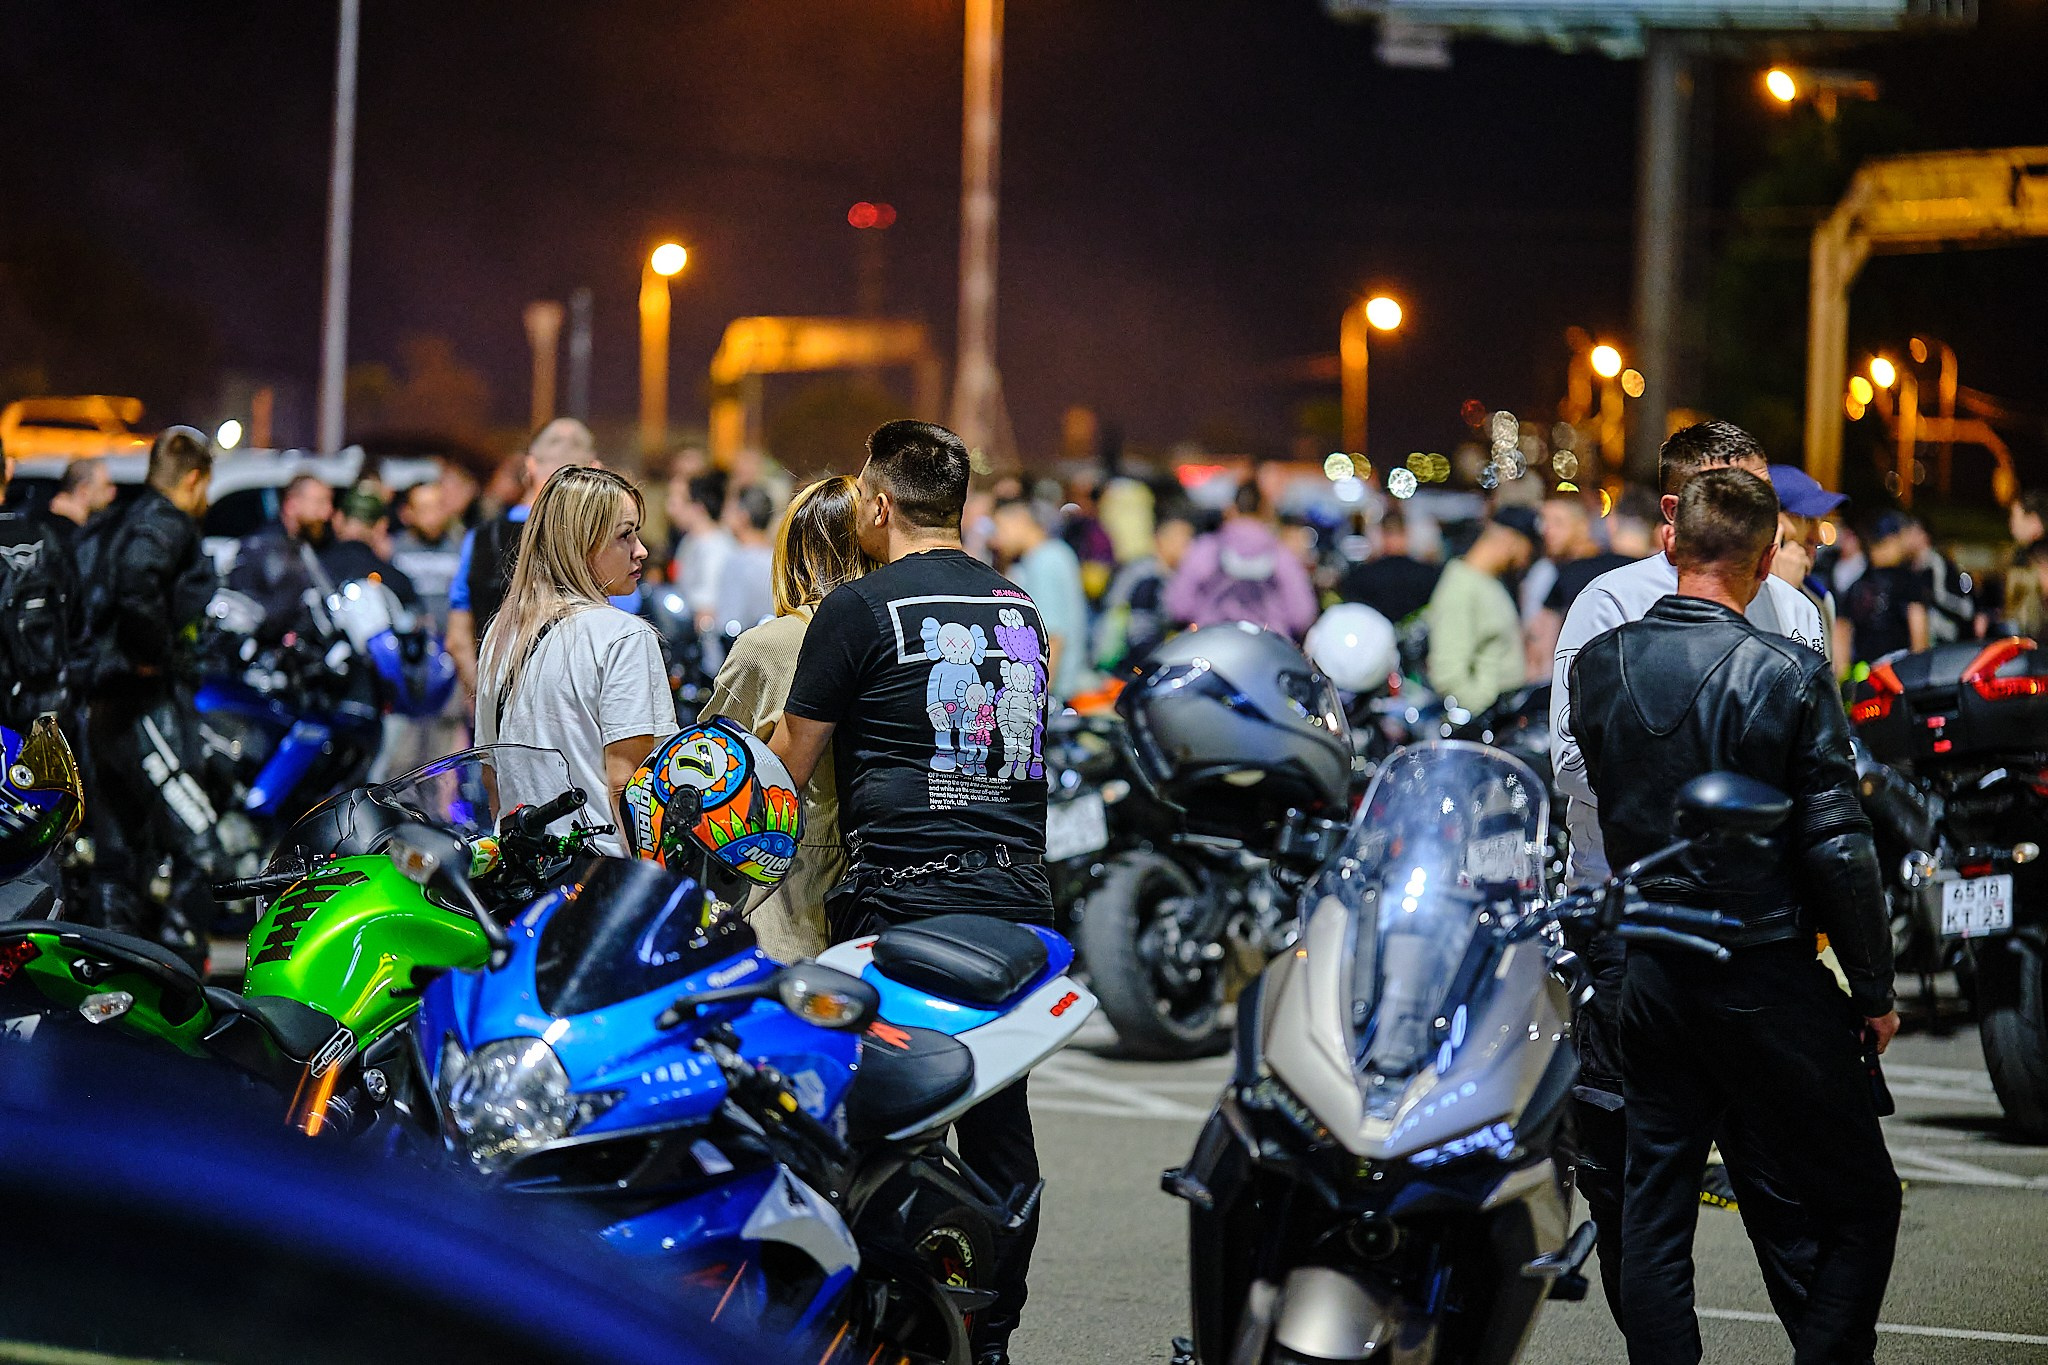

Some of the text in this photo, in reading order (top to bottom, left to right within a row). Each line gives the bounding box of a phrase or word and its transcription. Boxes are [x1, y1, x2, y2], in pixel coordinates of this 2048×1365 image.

[676, 743, 716, 779] 7
[928, 778, 951, 786] Defining
[638, 771, 654, 852] NOLAN
[943, 798, 956, 806] York,
